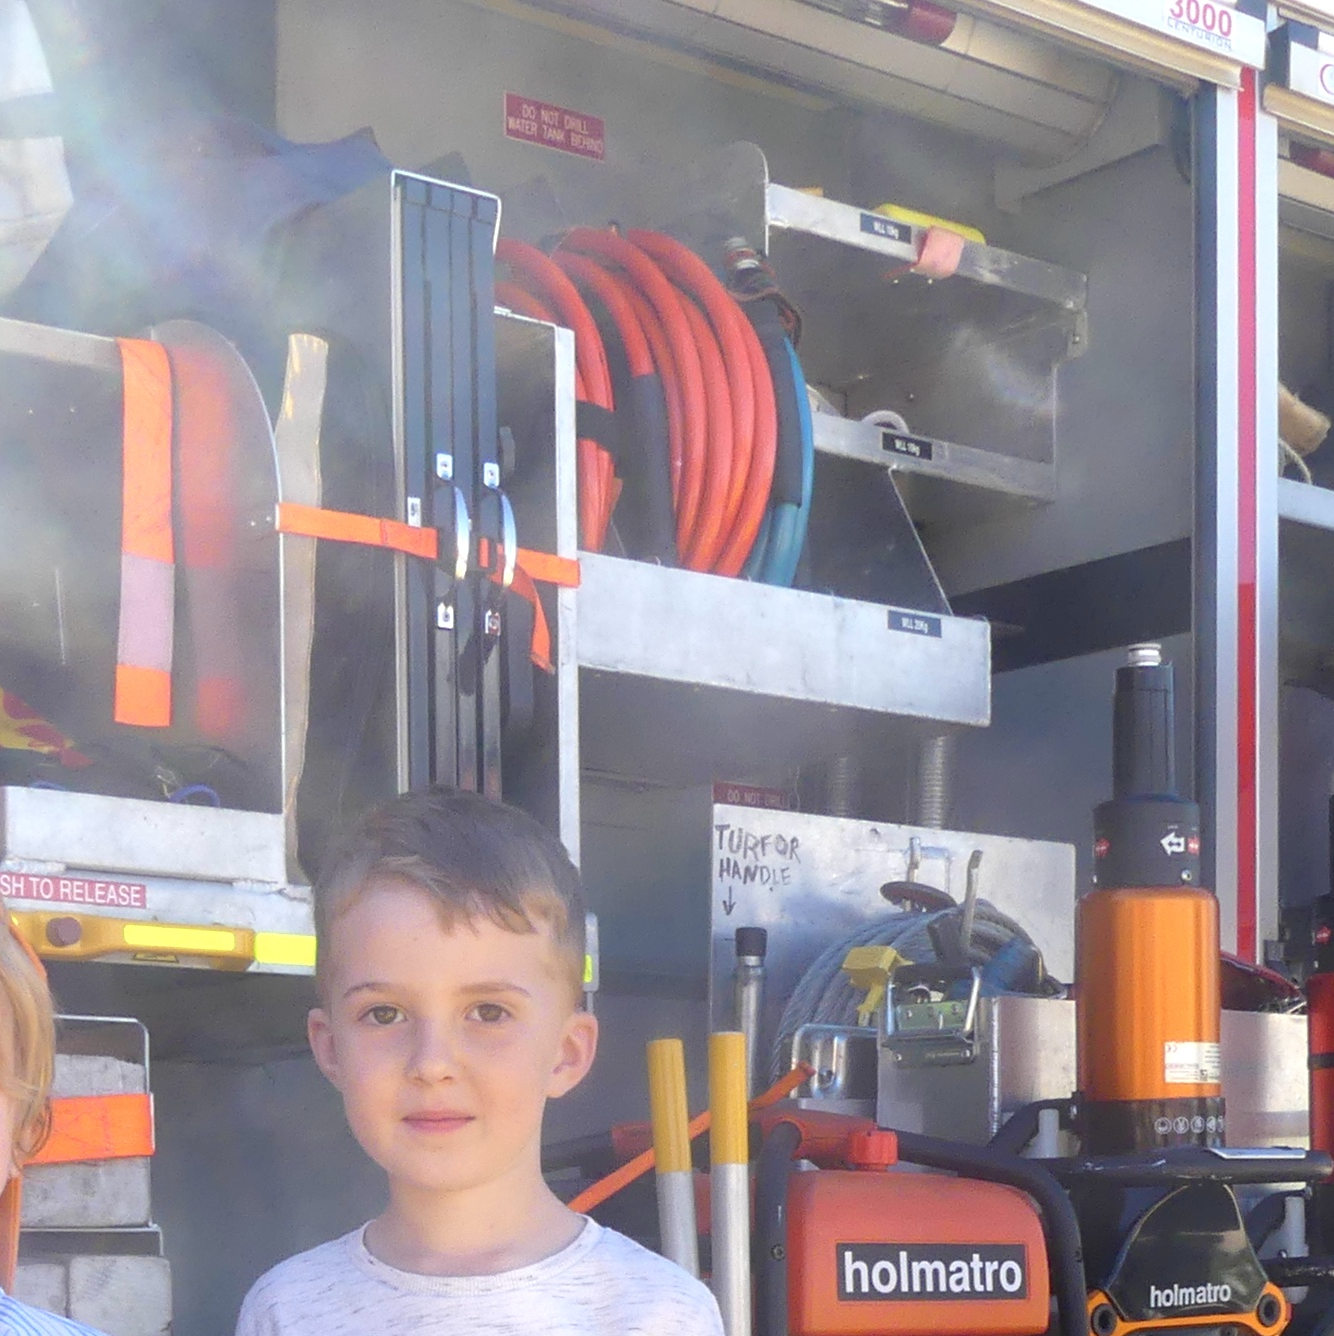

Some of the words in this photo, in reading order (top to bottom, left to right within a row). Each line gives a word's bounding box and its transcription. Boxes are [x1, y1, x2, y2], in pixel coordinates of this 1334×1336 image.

[1169, 0, 1233, 38] 3000
[715, 824, 802, 864] TURFOR
[718, 856, 792, 887] HANDLE
[28, 876, 54, 899] TO
[59, 880, 142, 907] RELEASE
[843, 1250, 1023, 1295] holmatro
[1149, 1282, 1233, 1309] holmatro
